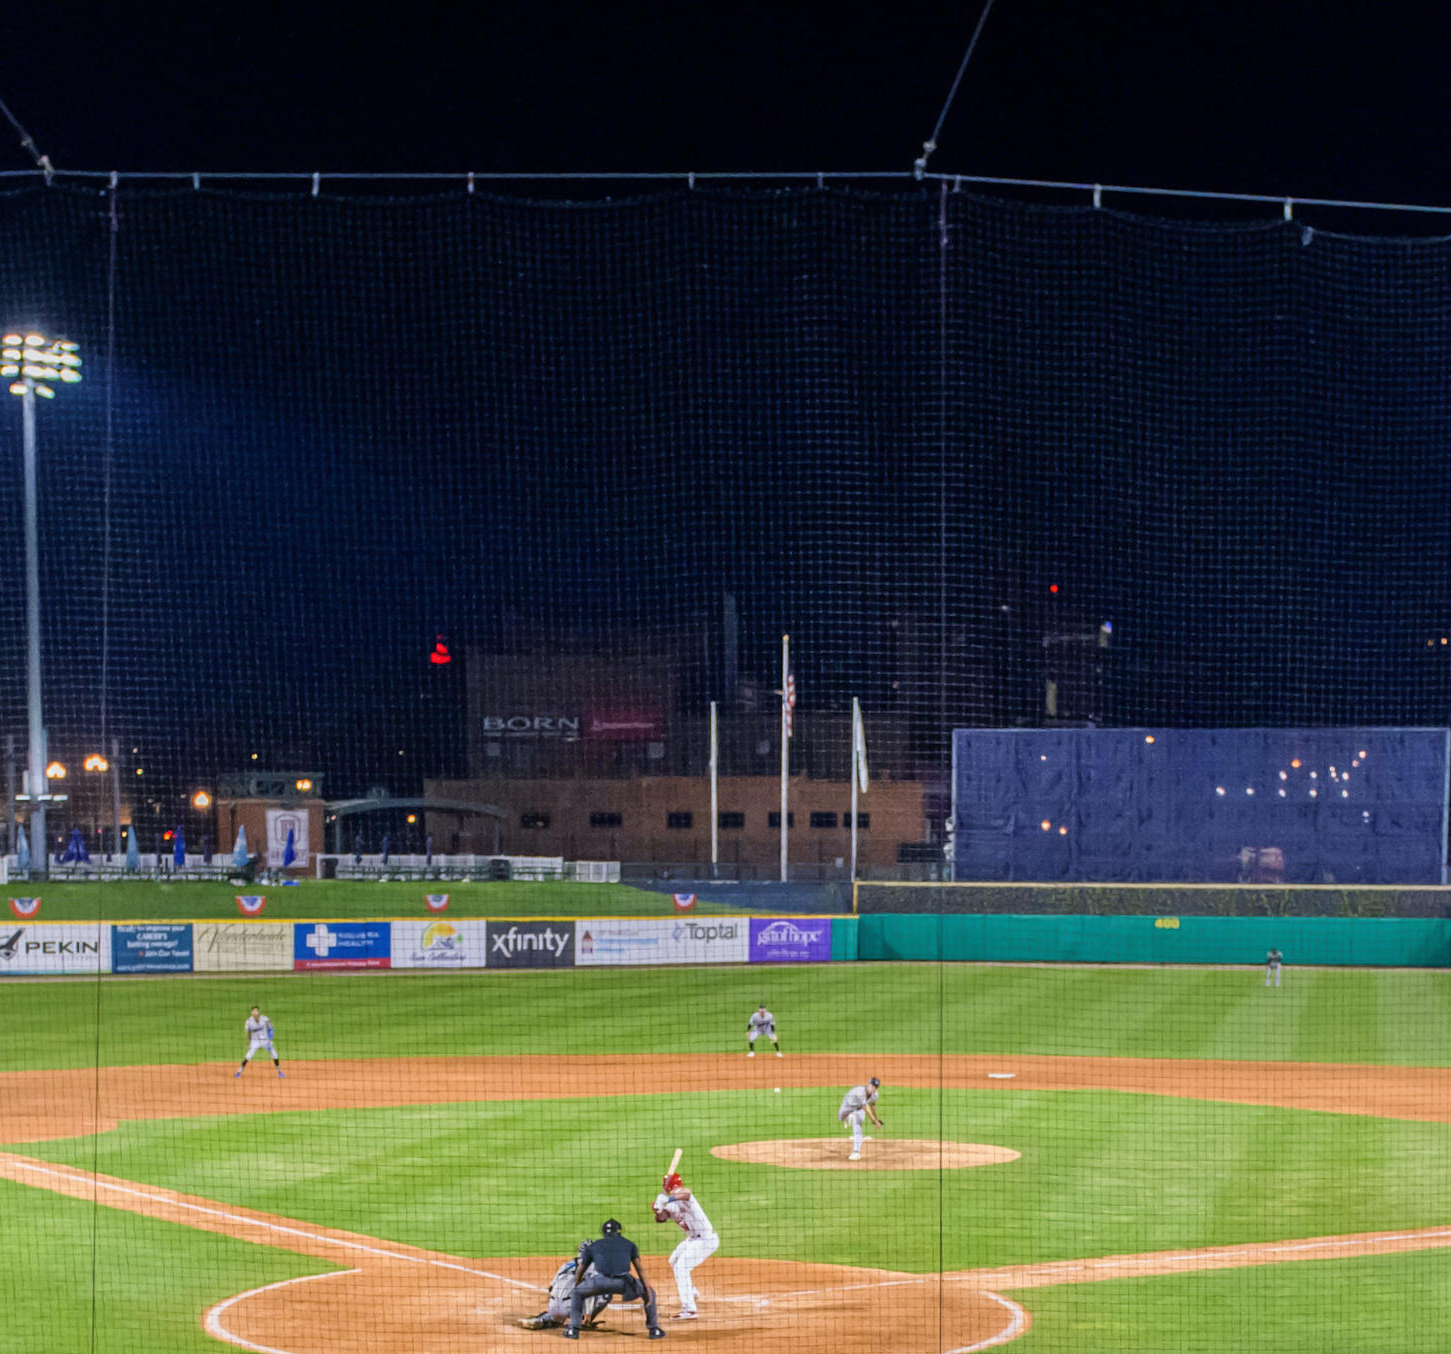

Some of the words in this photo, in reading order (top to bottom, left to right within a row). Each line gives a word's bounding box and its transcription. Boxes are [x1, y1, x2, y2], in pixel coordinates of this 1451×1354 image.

[483, 714, 580, 731] BORN
[1154, 917, 1180, 929] 400
[492, 926, 570, 958] xfinity
[685, 923, 738, 944] Toptal
[25, 941, 99, 954] PEKIN
